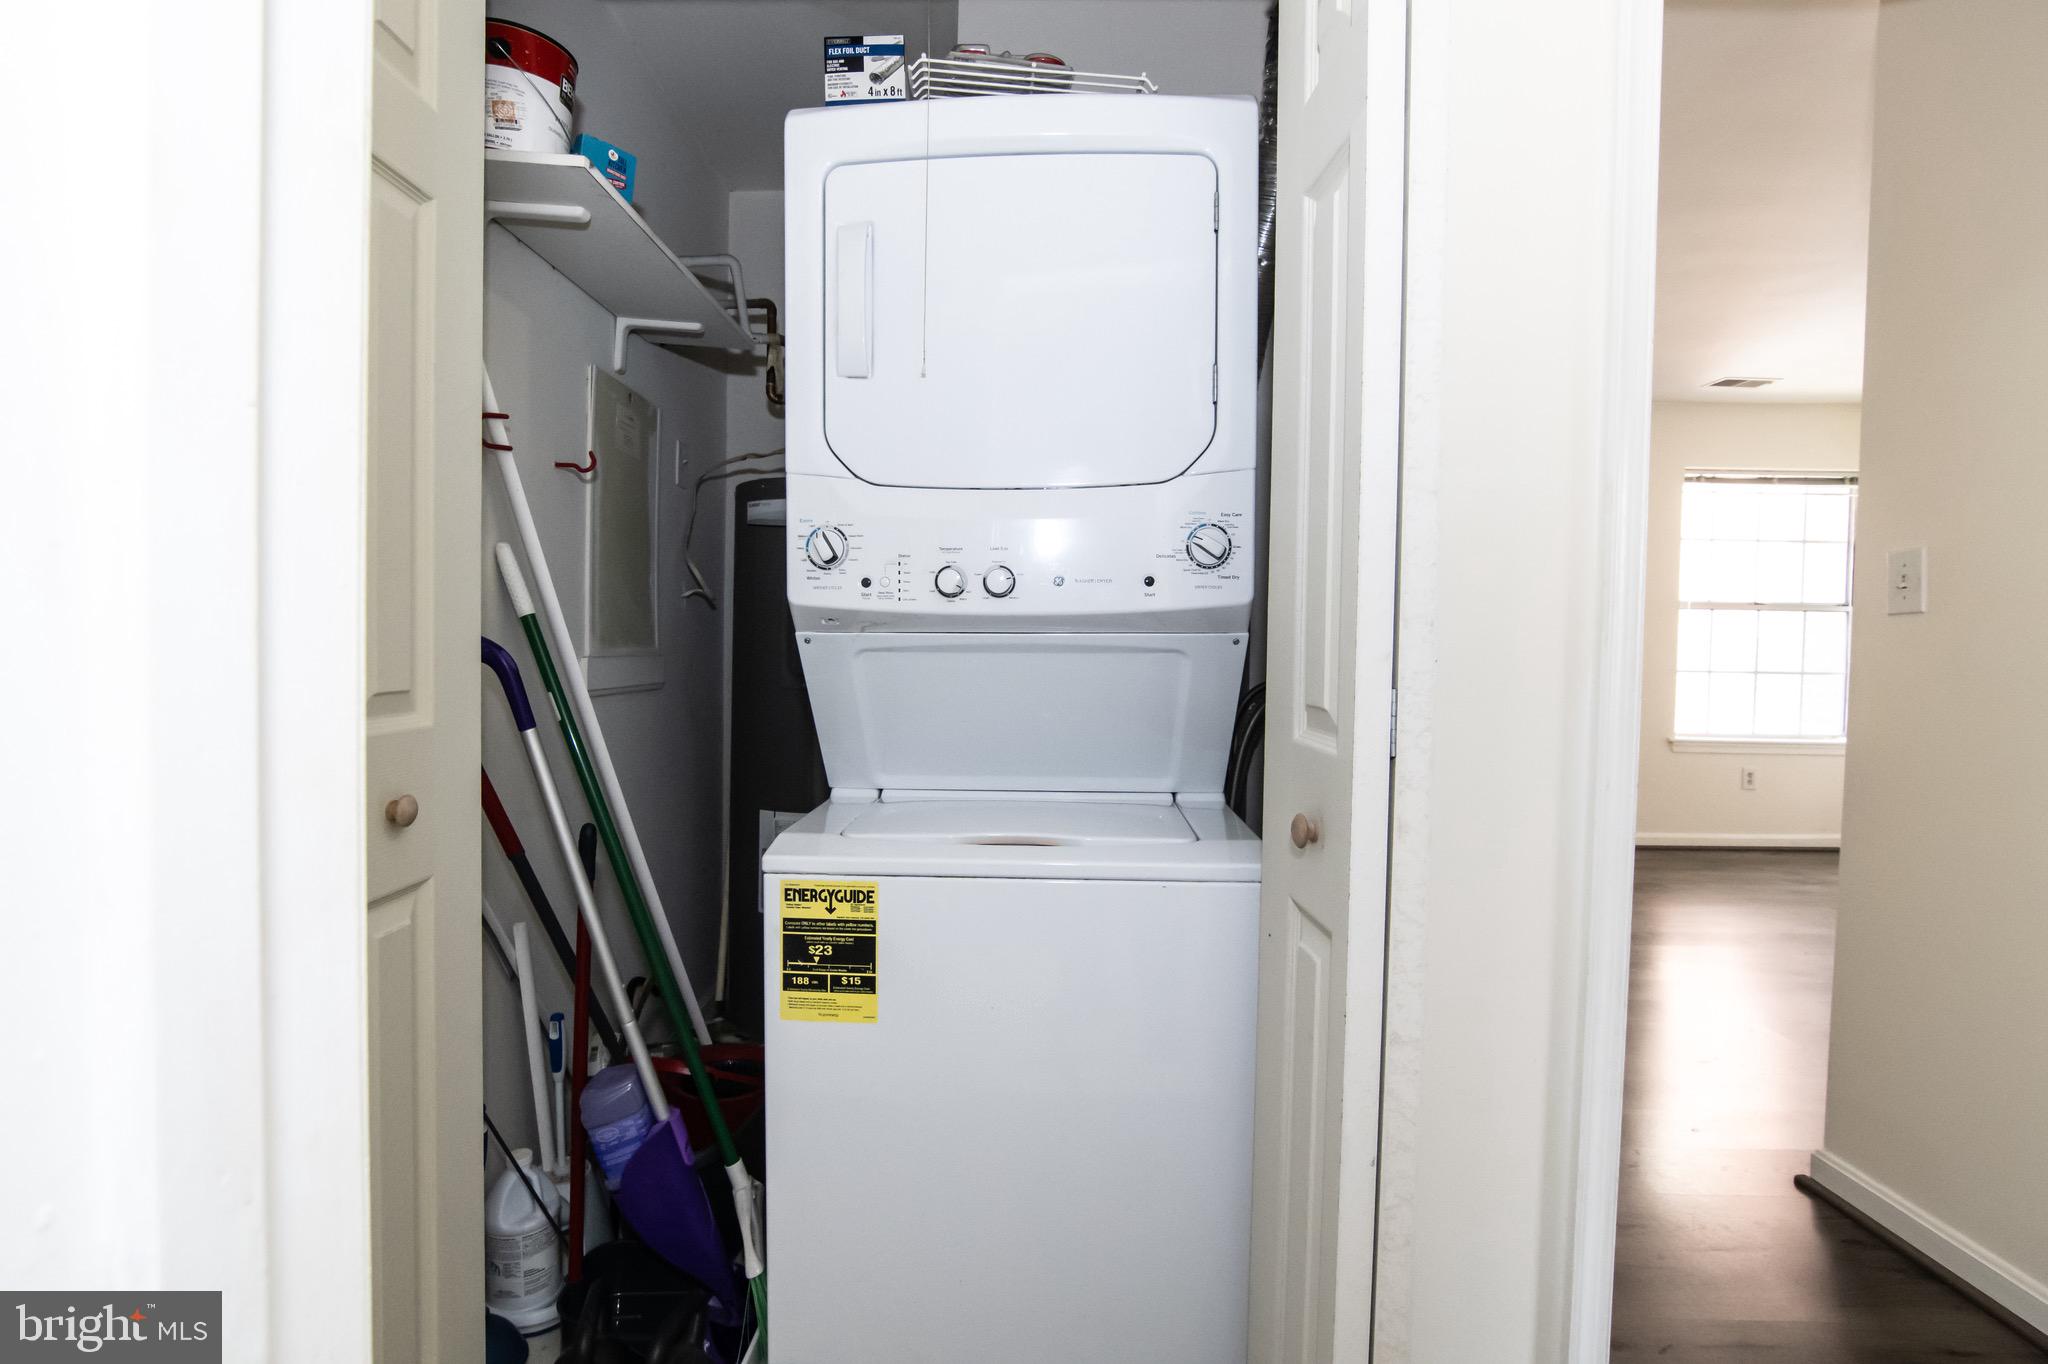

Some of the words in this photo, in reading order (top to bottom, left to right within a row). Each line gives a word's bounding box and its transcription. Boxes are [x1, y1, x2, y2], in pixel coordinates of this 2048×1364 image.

[856, 46, 870, 54] DUCT
[868, 86, 873, 96] 4
[875, 88, 881, 96] in
[883, 88, 888, 96] x
[890, 85, 896, 96] 8
[897, 88, 902, 96] ft
[784, 887, 875, 904] ENERGYGUIDE
[808, 944, 833, 956] $23
[791, 976, 809, 985] 188
[841, 976, 861, 985] $15
